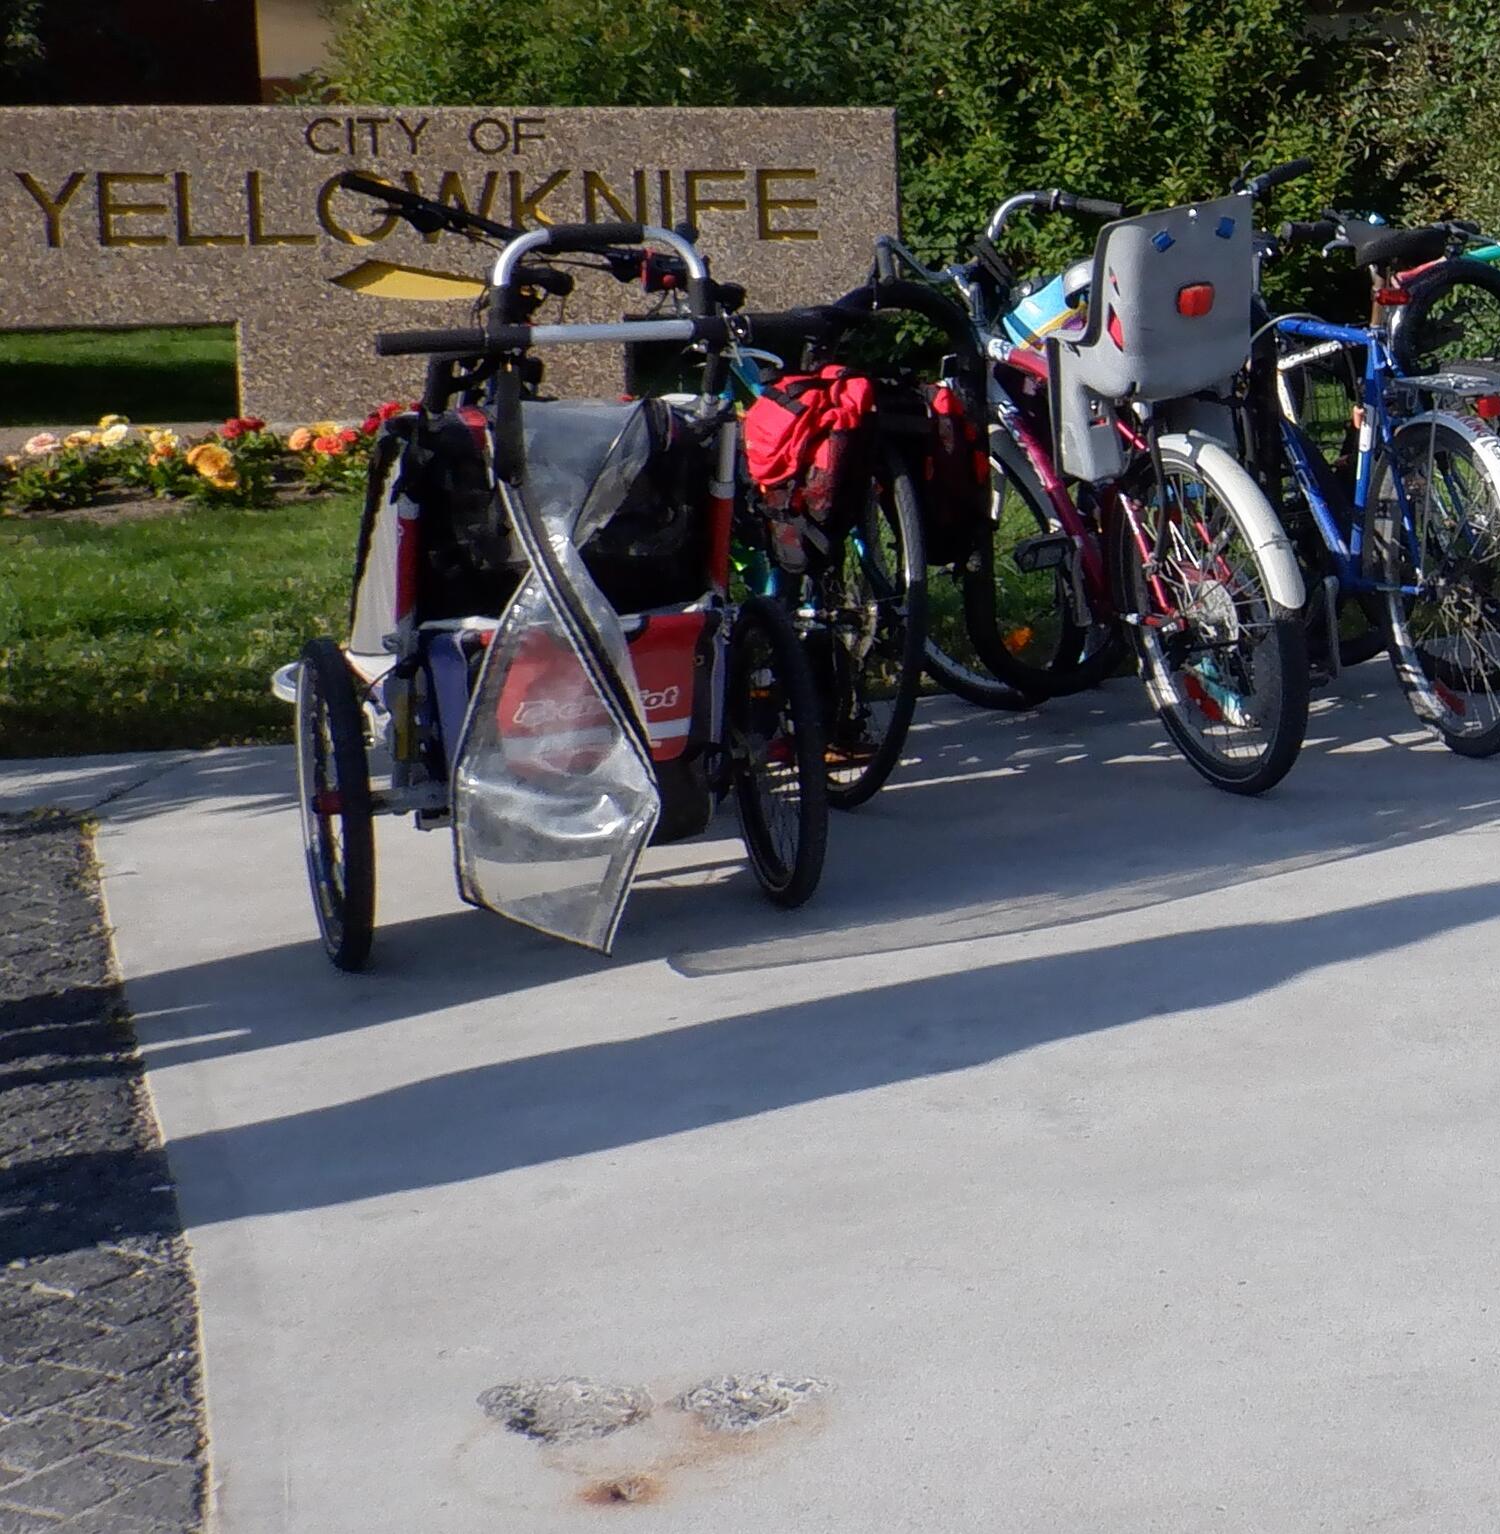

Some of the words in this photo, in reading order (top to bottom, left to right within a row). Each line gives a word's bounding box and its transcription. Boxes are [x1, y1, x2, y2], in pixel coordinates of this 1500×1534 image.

[305, 116, 429, 156] CITY
[469, 116, 546, 156] OF
[15, 168, 820, 248] YELLOWKNIFE
